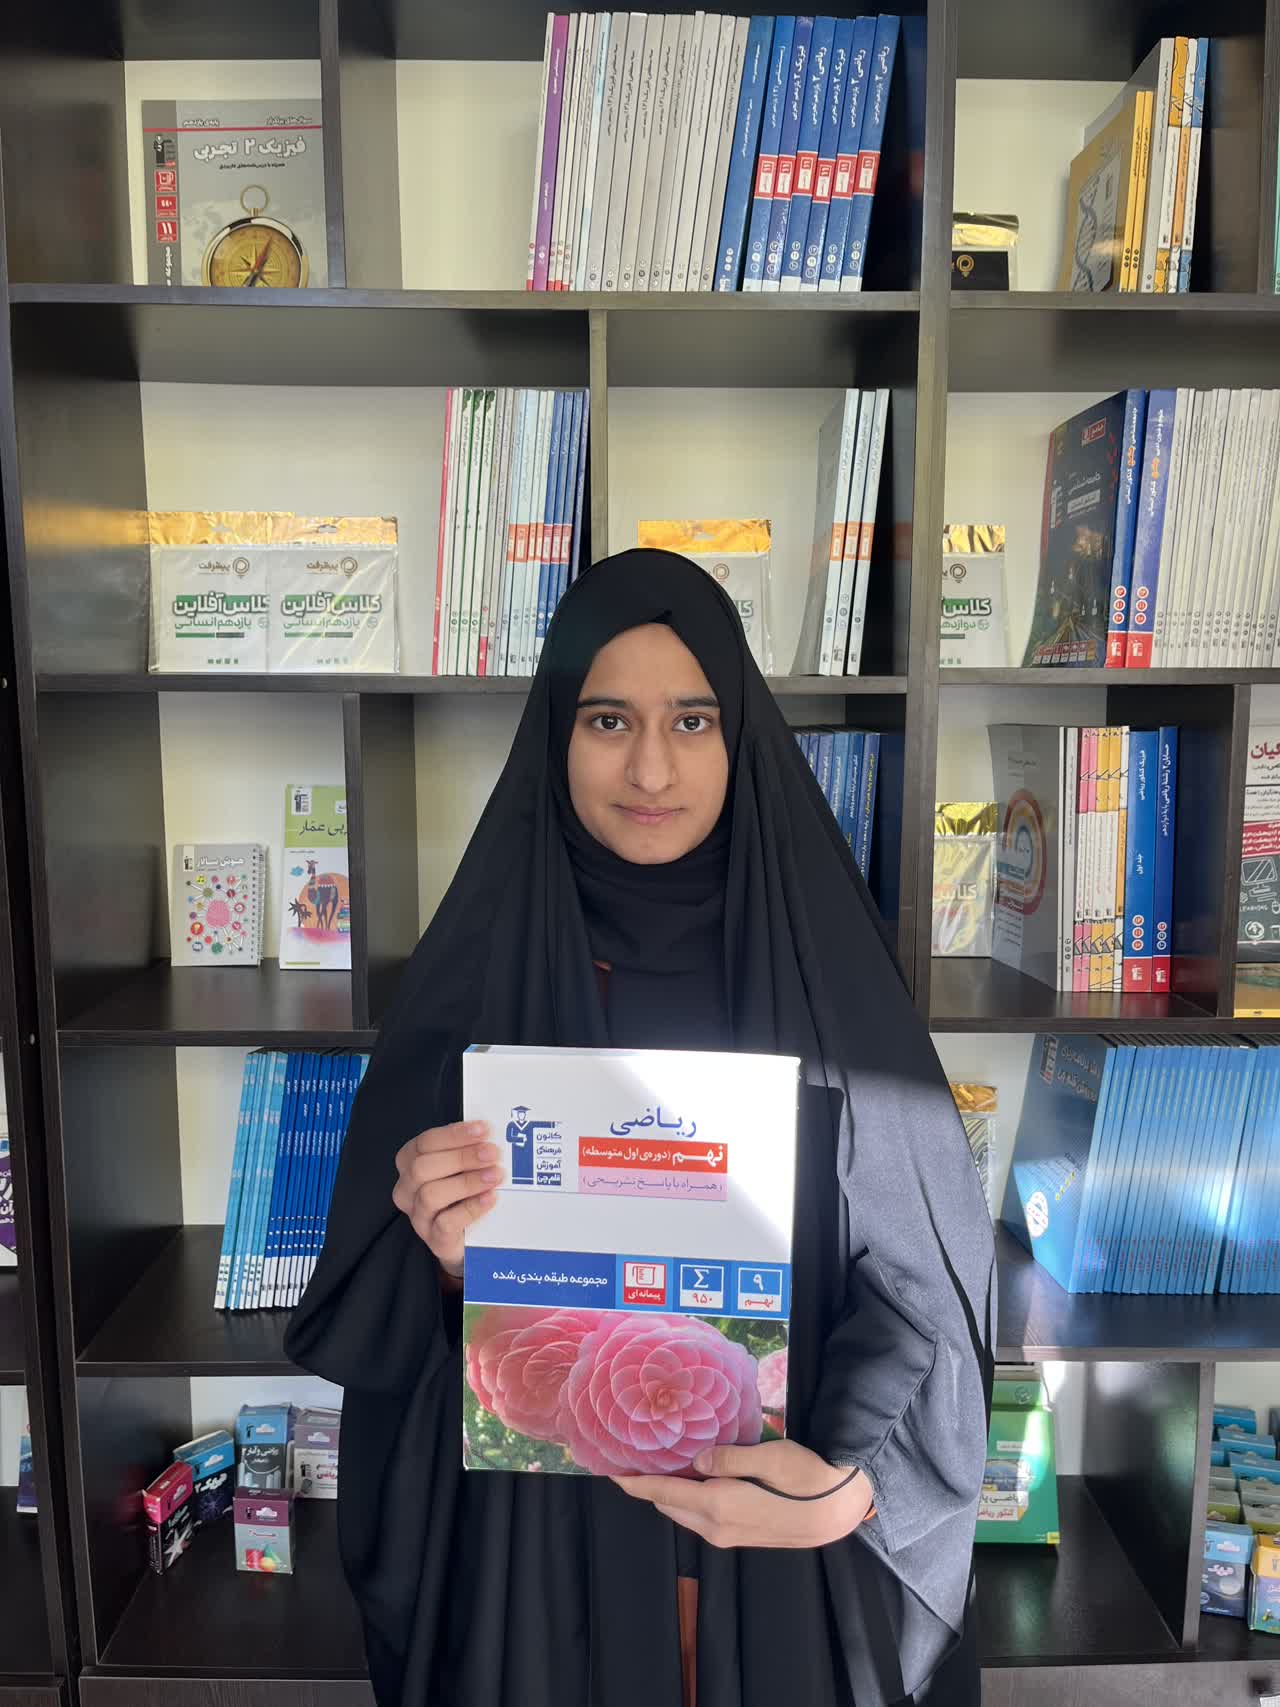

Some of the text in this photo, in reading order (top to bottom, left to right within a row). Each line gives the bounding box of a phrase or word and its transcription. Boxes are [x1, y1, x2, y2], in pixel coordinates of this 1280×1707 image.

[795, 45, 806, 72] فیزیک
[815, 47, 827, 75] ریاضی
[836, 49, 846, 76] فیزیک
[853, 49, 866, 78] ریاضی
[877, 46, 890, 74] ریاضی
[193, 136, 306, 162] فیزیک ۲ تجربی
[198, 561, 231, 573] پیشرفت
[306, 560, 338, 573] پیشرفت
[173, 591, 269, 615] کلاس آفلاین
[282, 591, 382, 616] کلاس آفلاین
[942, 598, 992, 618] کلاس
[174, 616, 252, 630] یازدهم انسانی
[283, 616, 360, 630] یازدهم انسانی
[942, 619, 976, 630] دوازده
[610, 1105, 697, 1137] ریاضی
[536, 1131, 562, 1141] کانون
[536, 1145, 562, 1155] فرهنگی
[582, 1146, 623, 1159] متوسطه)
[623, 1147, 639, 1160] اول
[673, 1145, 723, 1167] نهم
[536, 1159, 561, 1170] آموزش
[638, 1177, 671, 1191] پاسخ
[672, 1178, 681, 1189] با
[492, 1269, 608, 1287] مجموعه طبقه بندی شده
[753, 1273, 764, 1292] ۹
[692, 1293, 713, 1304] ۹۵۰
[744, 1297, 774, 1309] نهم
[200, 1473, 228, 1492] فیزیک
